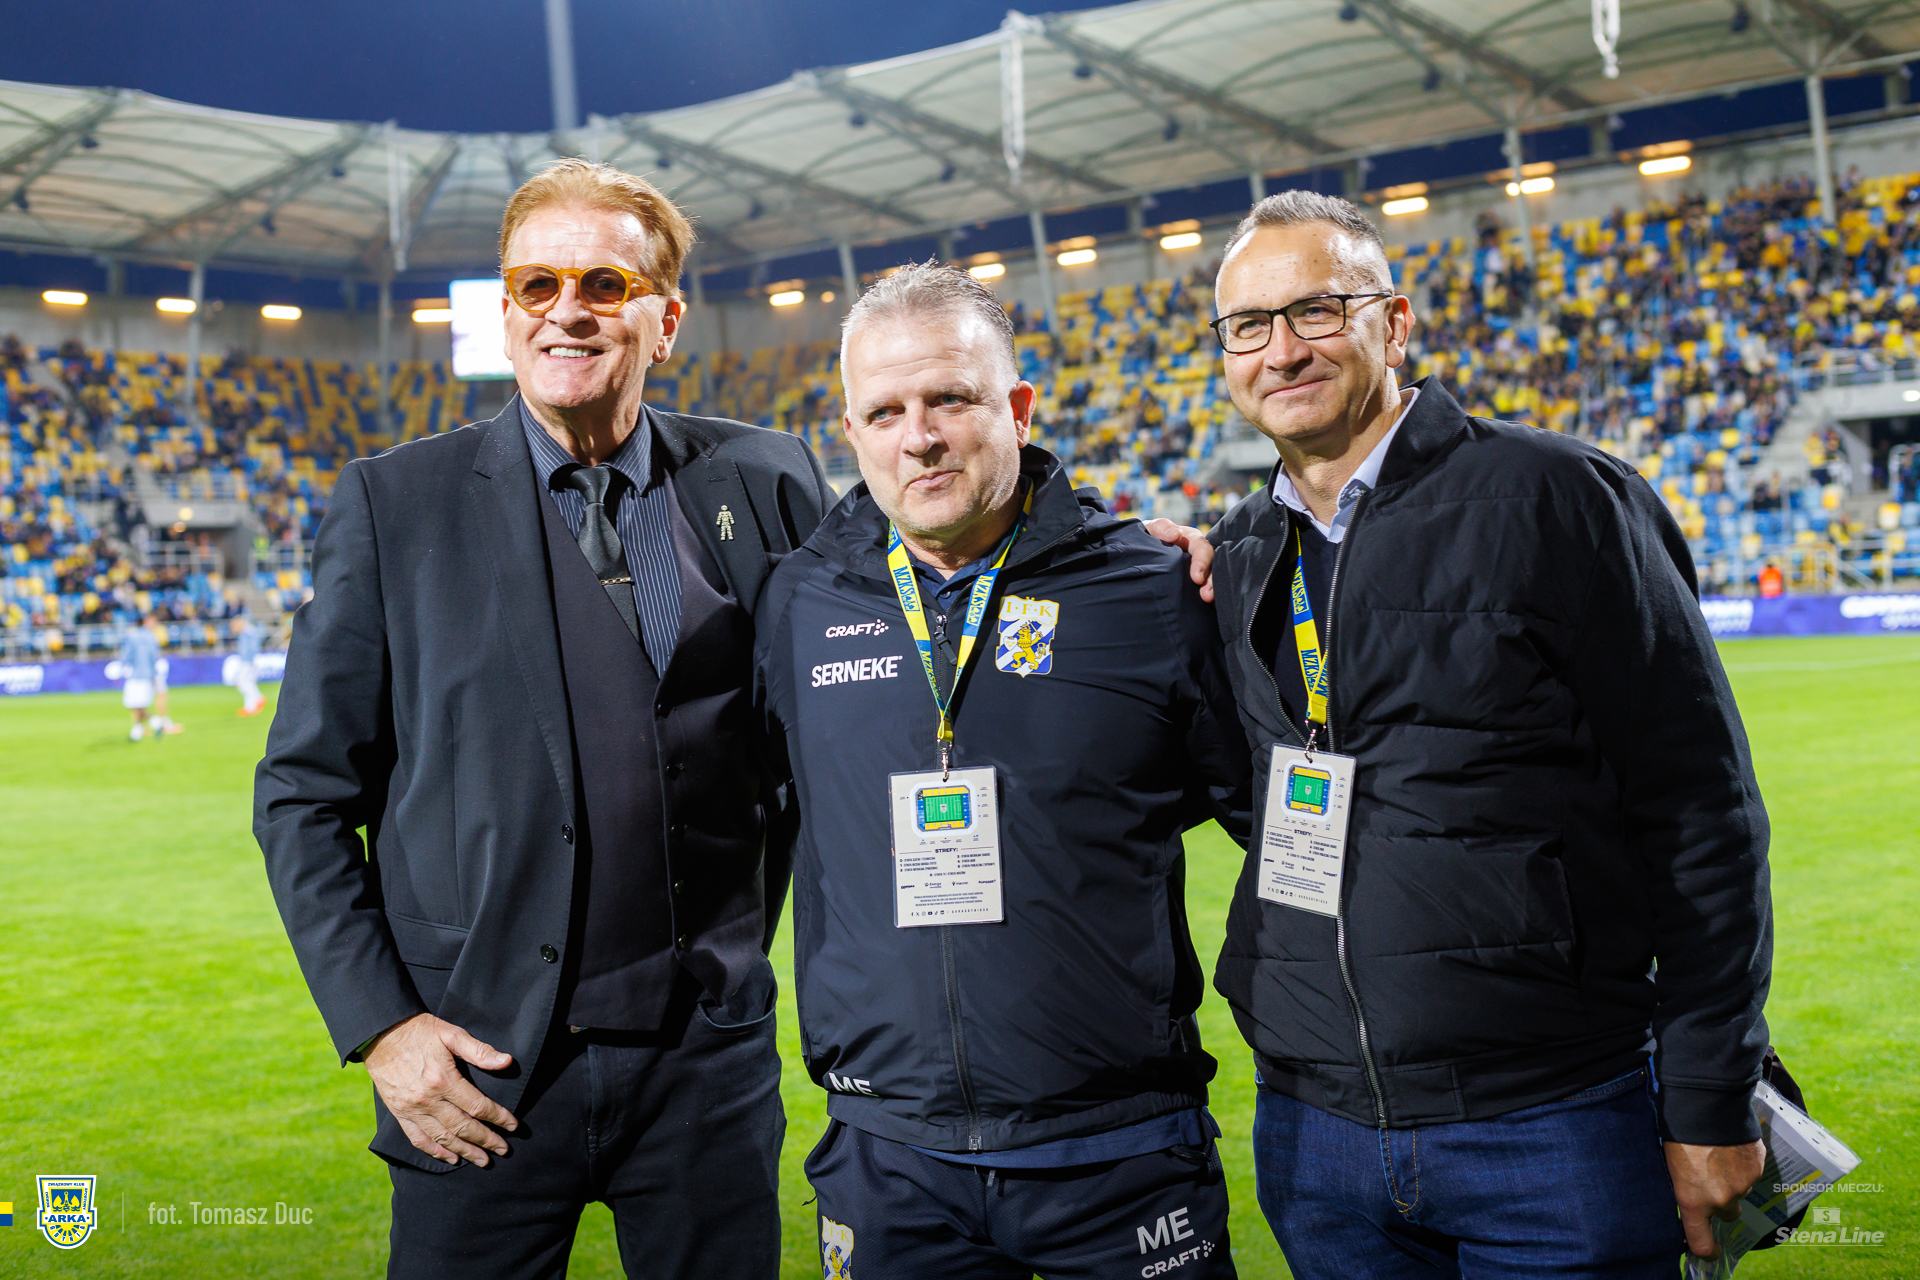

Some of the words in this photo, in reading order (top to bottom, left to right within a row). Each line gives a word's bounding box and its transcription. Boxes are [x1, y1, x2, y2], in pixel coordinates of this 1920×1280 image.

[825, 622, 876, 639] CRAFT
[811, 655, 899, 688] SERNEKE
[829, 1072, 880, 1097] ME
[1136, 1206, 1195, 1255] ME
[1141, 1246, 1201, 1279] CRAFT
